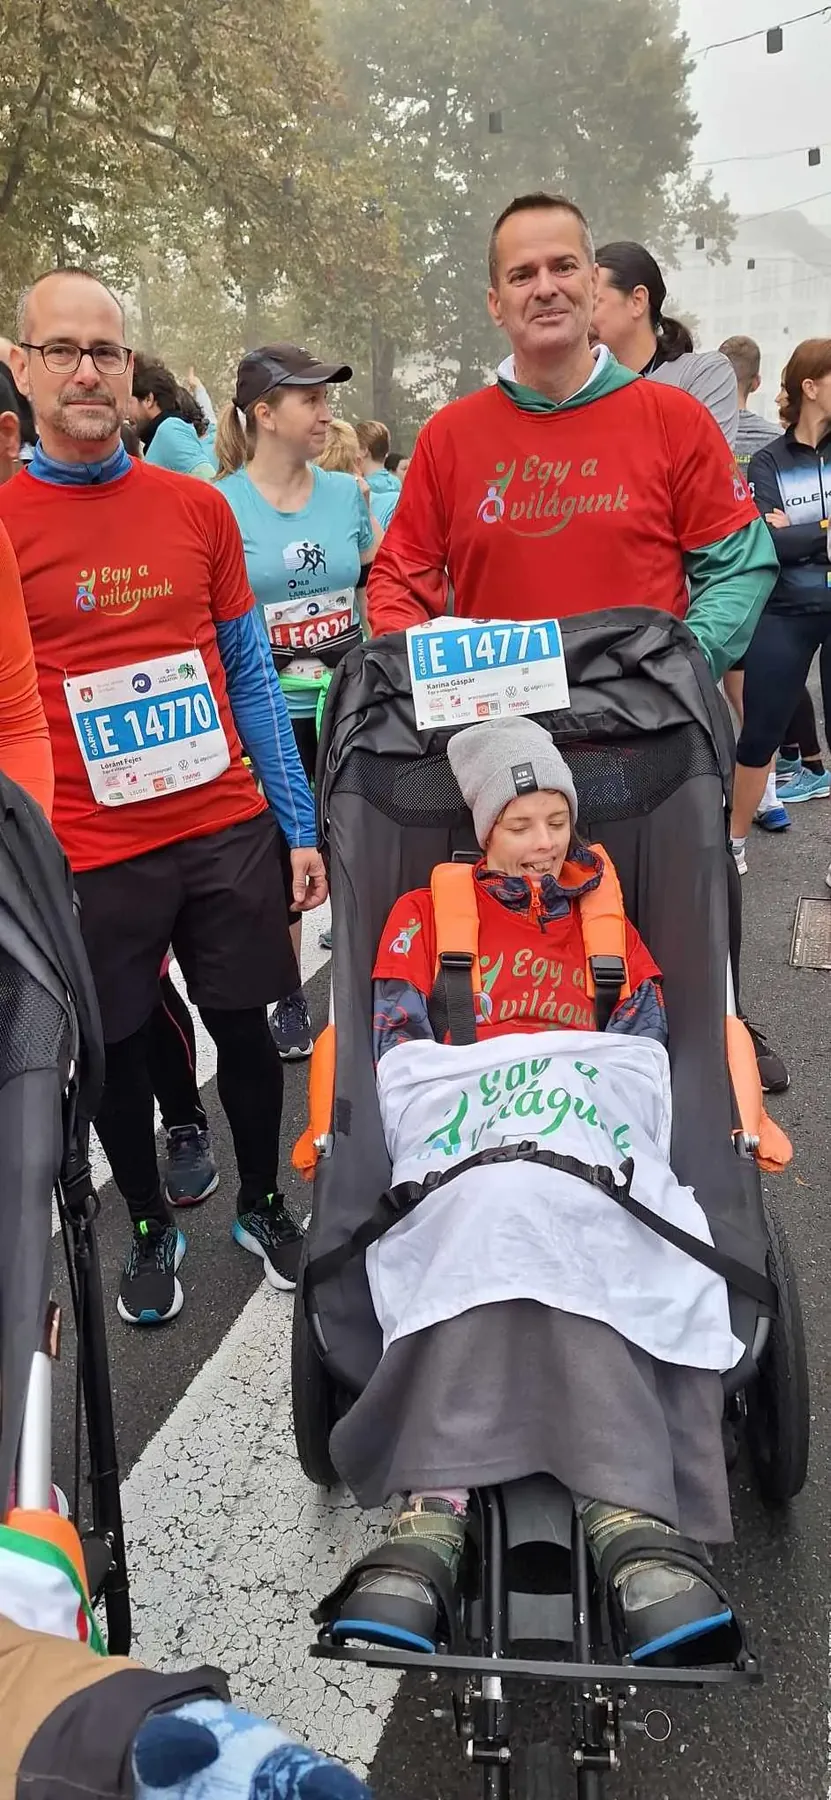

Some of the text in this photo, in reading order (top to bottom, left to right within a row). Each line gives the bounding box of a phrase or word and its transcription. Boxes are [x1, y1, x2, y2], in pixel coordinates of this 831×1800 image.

[522, 455, 598, 489] Egy a
[506, 484, 629, 537] világunk
[101, 564, 149, 586] Egy a
[100, 578, 173, 616] világunk
[416, 638, 427, 675] GARMIN
[428, 627, 550, 674] E 14771
[426, 682, 450, 690] Karina
[82, 718, 98, 756] GARMIN
[96, 692, 212, 754] E 14770
[100, 756, 142, 770] Lóránt Fejes
[512, 948, 563, 988] Egy
